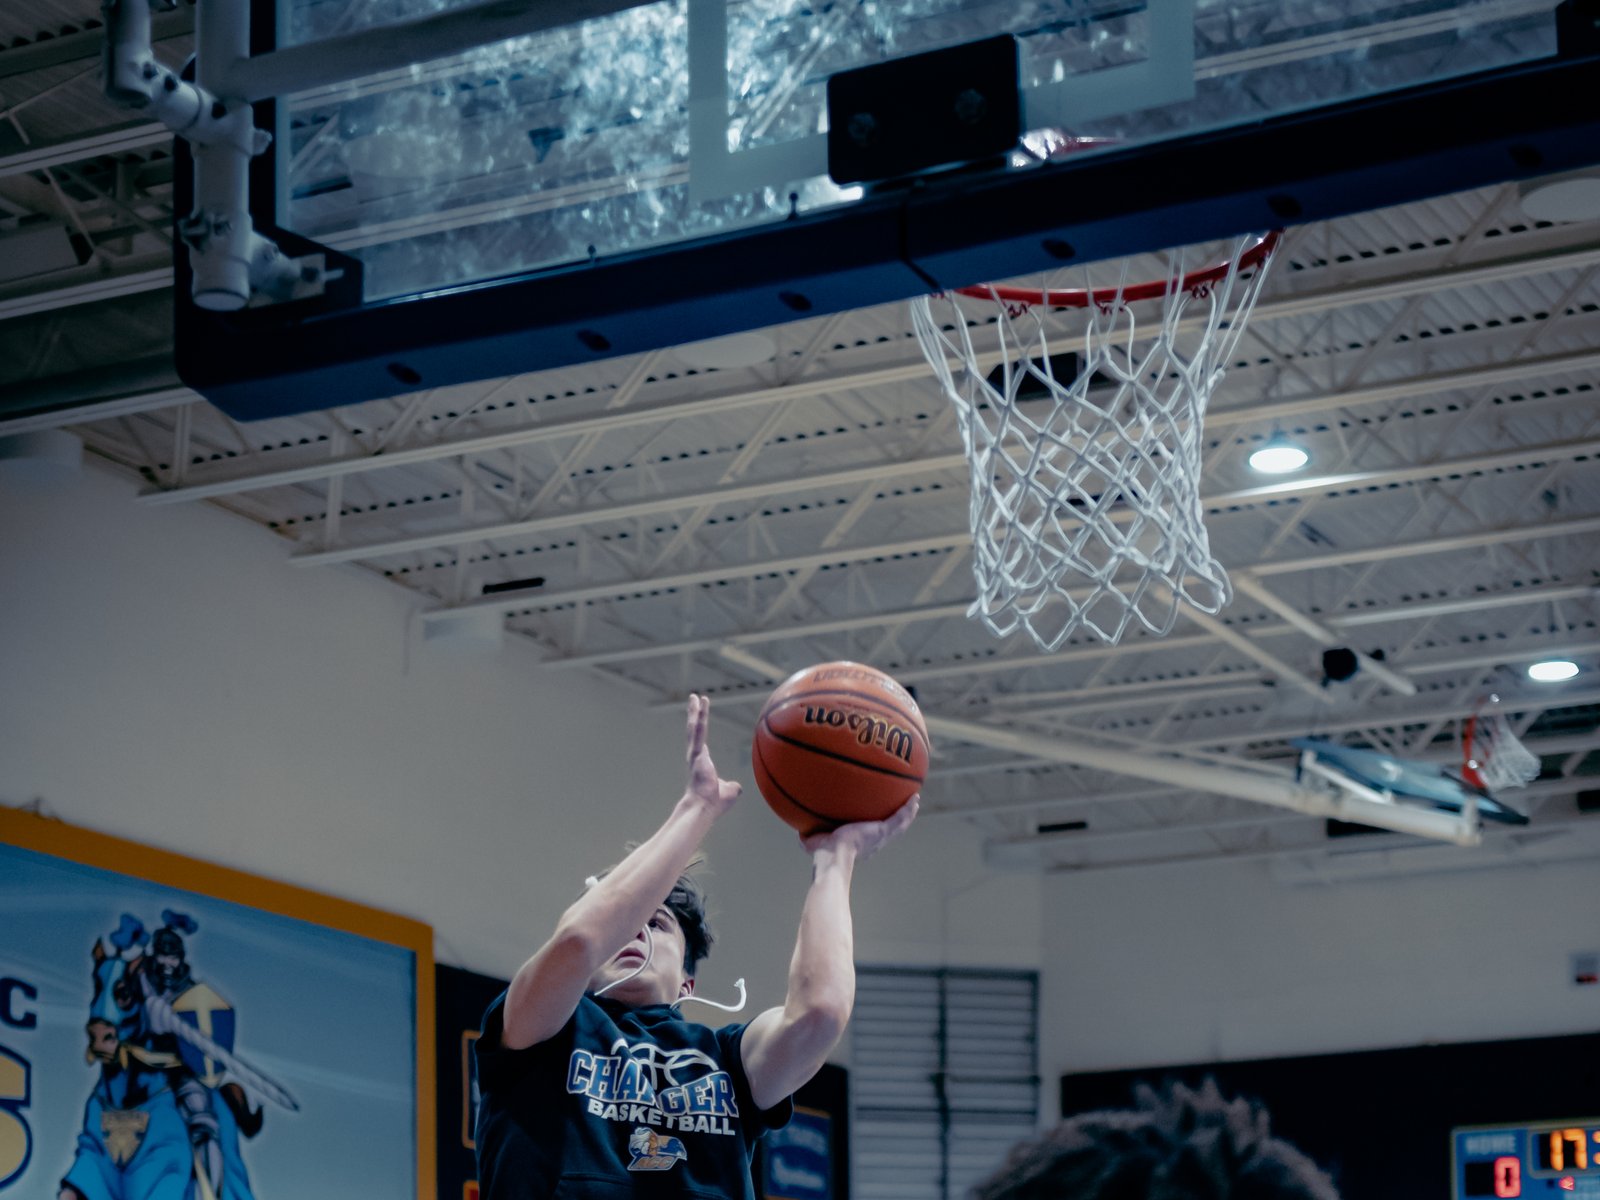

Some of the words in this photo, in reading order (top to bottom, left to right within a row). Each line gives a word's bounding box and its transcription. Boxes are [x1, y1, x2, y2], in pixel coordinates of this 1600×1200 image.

[803, 705, 914, 765] Wilson
[587, 1098, 736, 1136] BASKETBALL
[1494, 1156, 1520, 1198] 0
